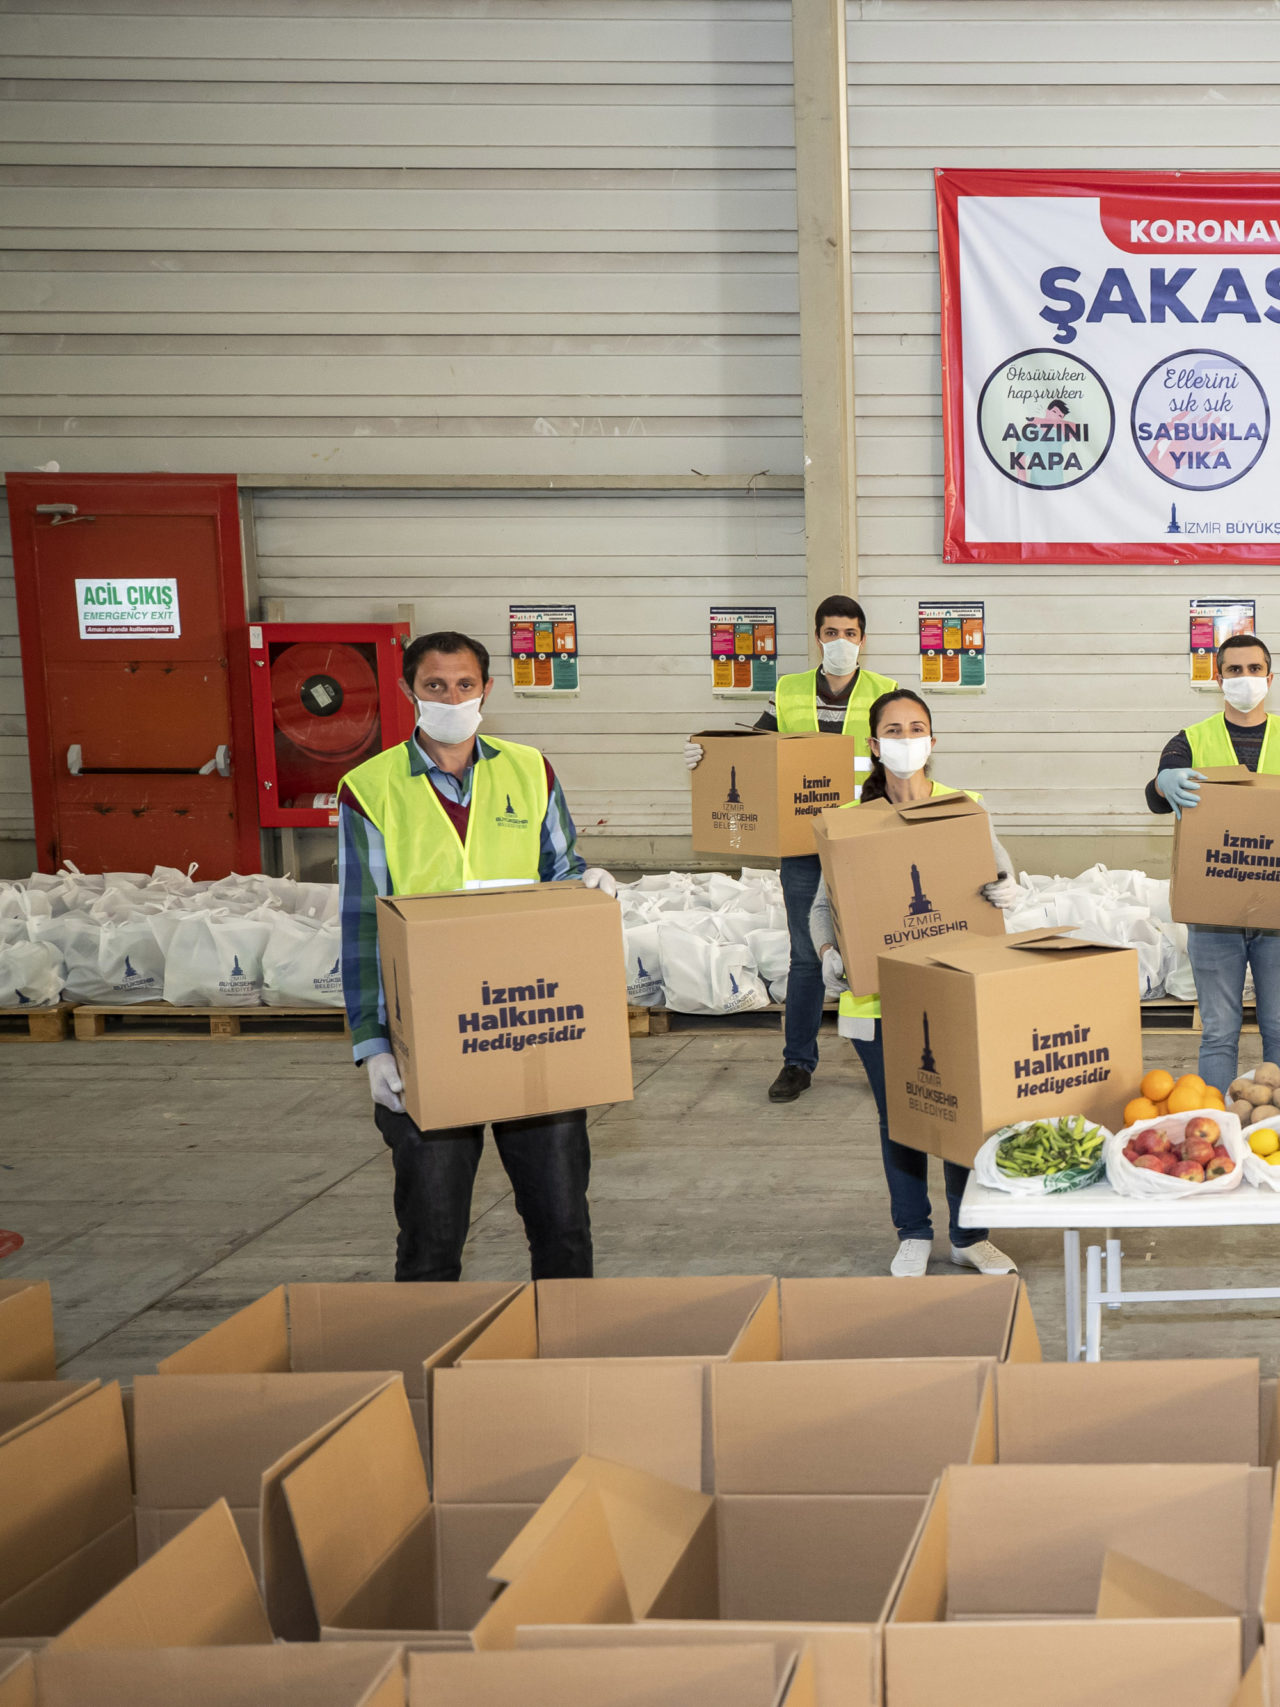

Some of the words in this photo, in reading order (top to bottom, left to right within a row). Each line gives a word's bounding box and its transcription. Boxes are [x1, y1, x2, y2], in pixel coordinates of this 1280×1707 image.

[1006, 364, 1087, 382] Öksürürken
[1163, 367, 1240, 390] Ellerini
[1007, 385, 1084, 402] hapşırırken
[1168, 392, 1199, 412] sık
[1203, 392, 1234, 412] sık
[1002, 417, 1089, 442] AĞZINI
[1138, 422, 1263, 442] SABUNLA
[1009, 451, 1084, 471] KAPA
[1169, 451, 1232, 470] YIKA
[1184, 521, 1221, 534] İZMİR
[84, 582, 123, 605] ACİL
[126, 585, 173, 610] ÇIKIŞ
[83, 611, 149, 620] EMERGENCY
[150, 611, 174, 620] EXIT
[803, 774, 831, 789] İzmir
[794, 790, 840, 804] Halkının
[1223, 829, 1274, 850] İzmir
[481, 978, 559, 1005] İzmir
[458, 1003, 584, 1033] Halkının
[462, 1025, 586, 1054] Hediyesidir
[1032, 1024, 1091, 1052] İzmir
[1014, 1047, 1109, 1080] Halkının
[1016, 1066, 1111, 1099] Hediyesidir
